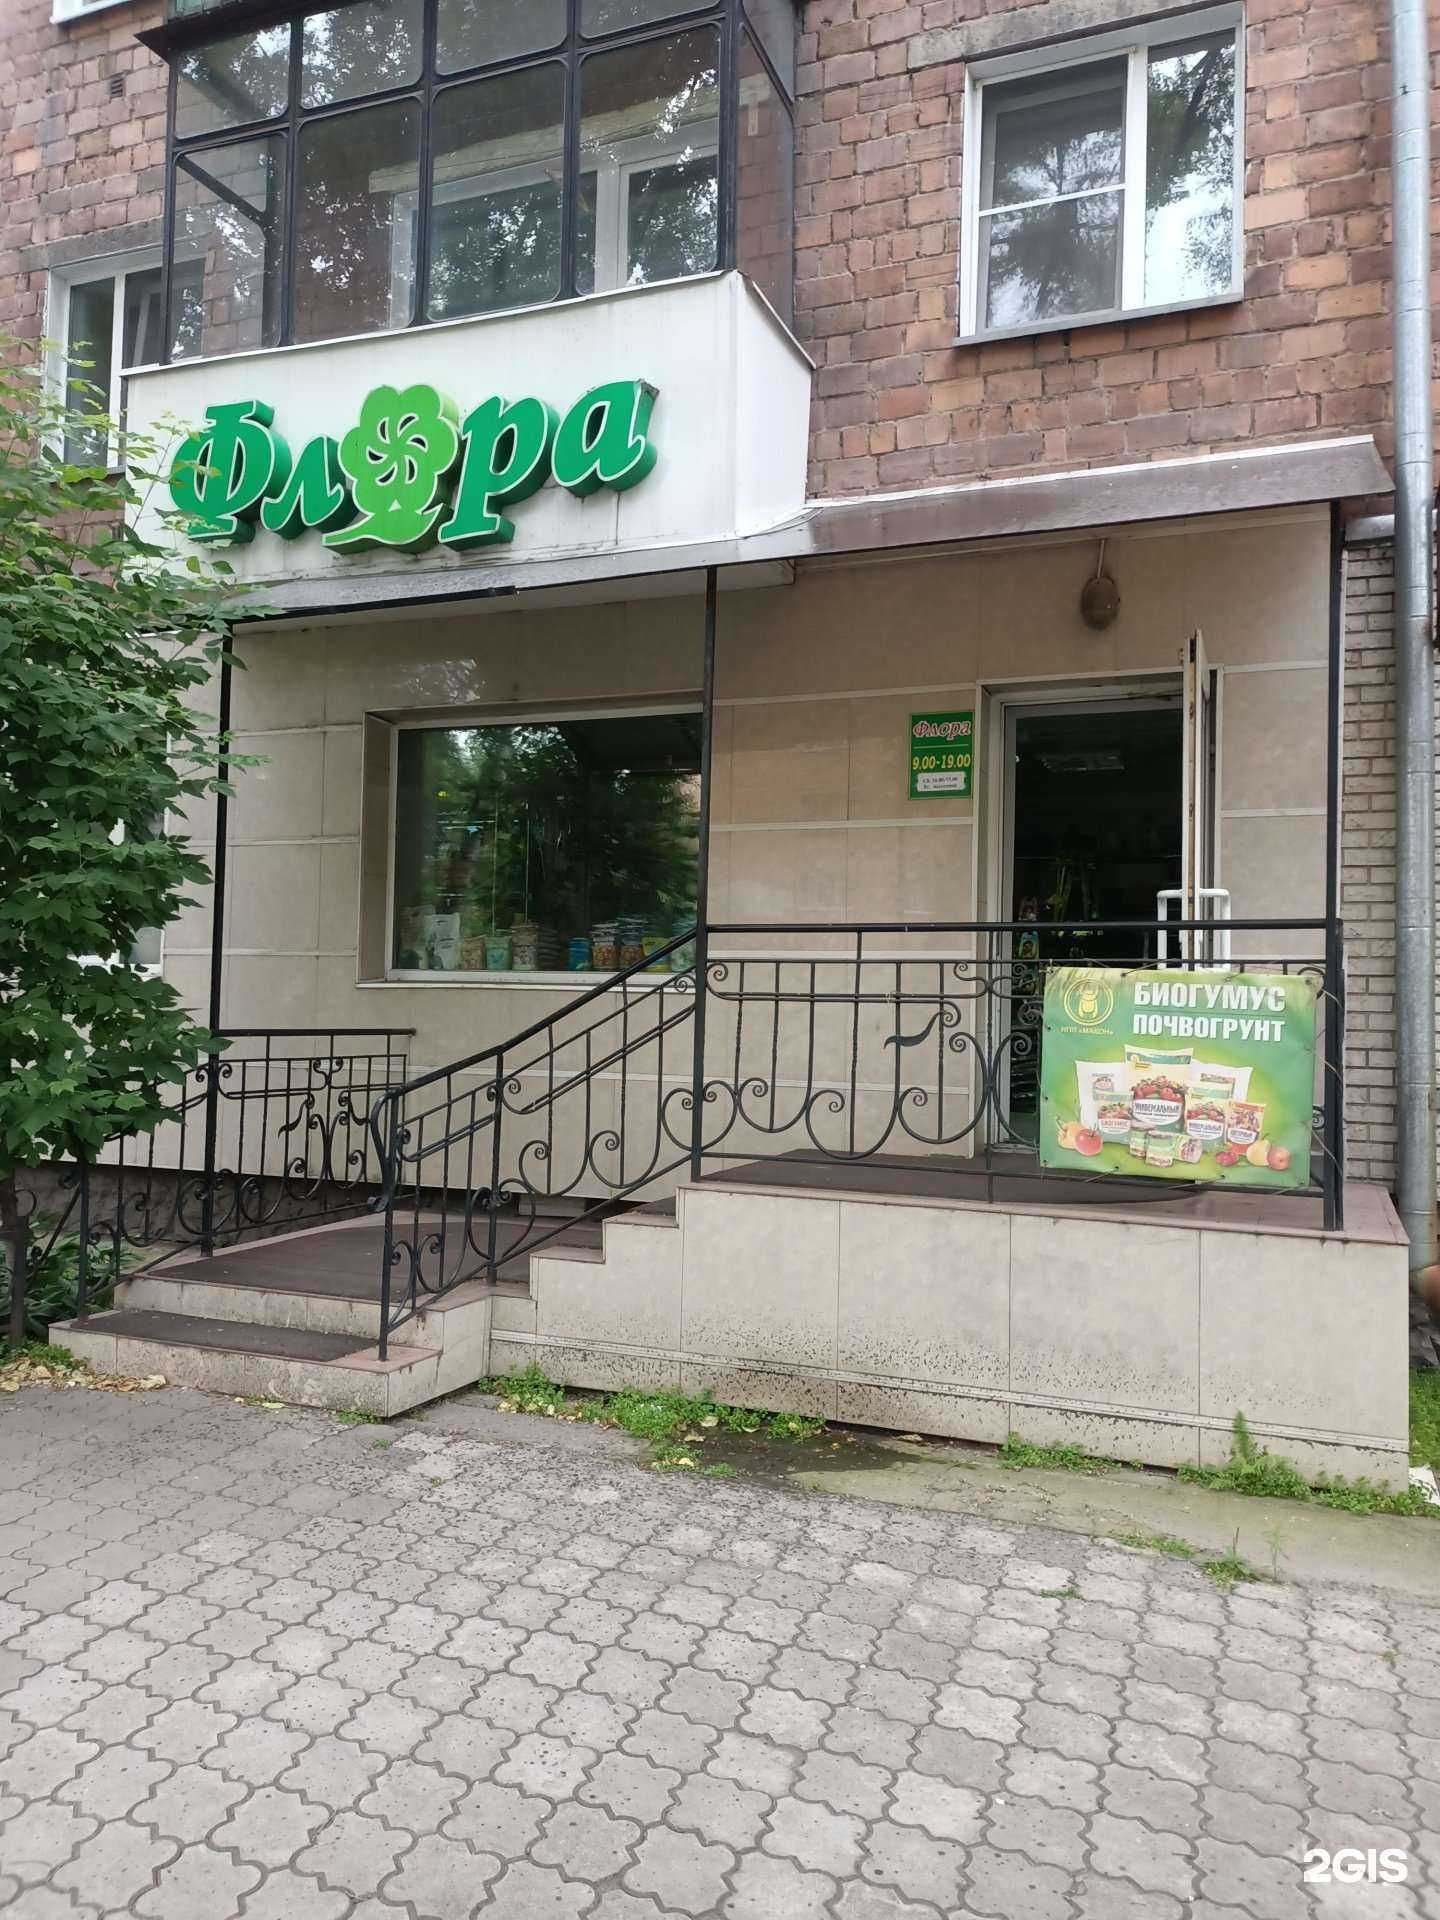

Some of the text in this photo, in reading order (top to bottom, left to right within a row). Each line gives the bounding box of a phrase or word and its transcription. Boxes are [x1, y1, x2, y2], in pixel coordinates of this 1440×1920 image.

[169, 379, 657, 553] Флора
[913, 720, 971, 740] Флора
[912, 754, 971, 770] 9.00-19.00
[1133, 981, 1286, 1012] БИОГУМУС
[1132, 1014, 1286, 1042] ПОЧВОГРУНТ
